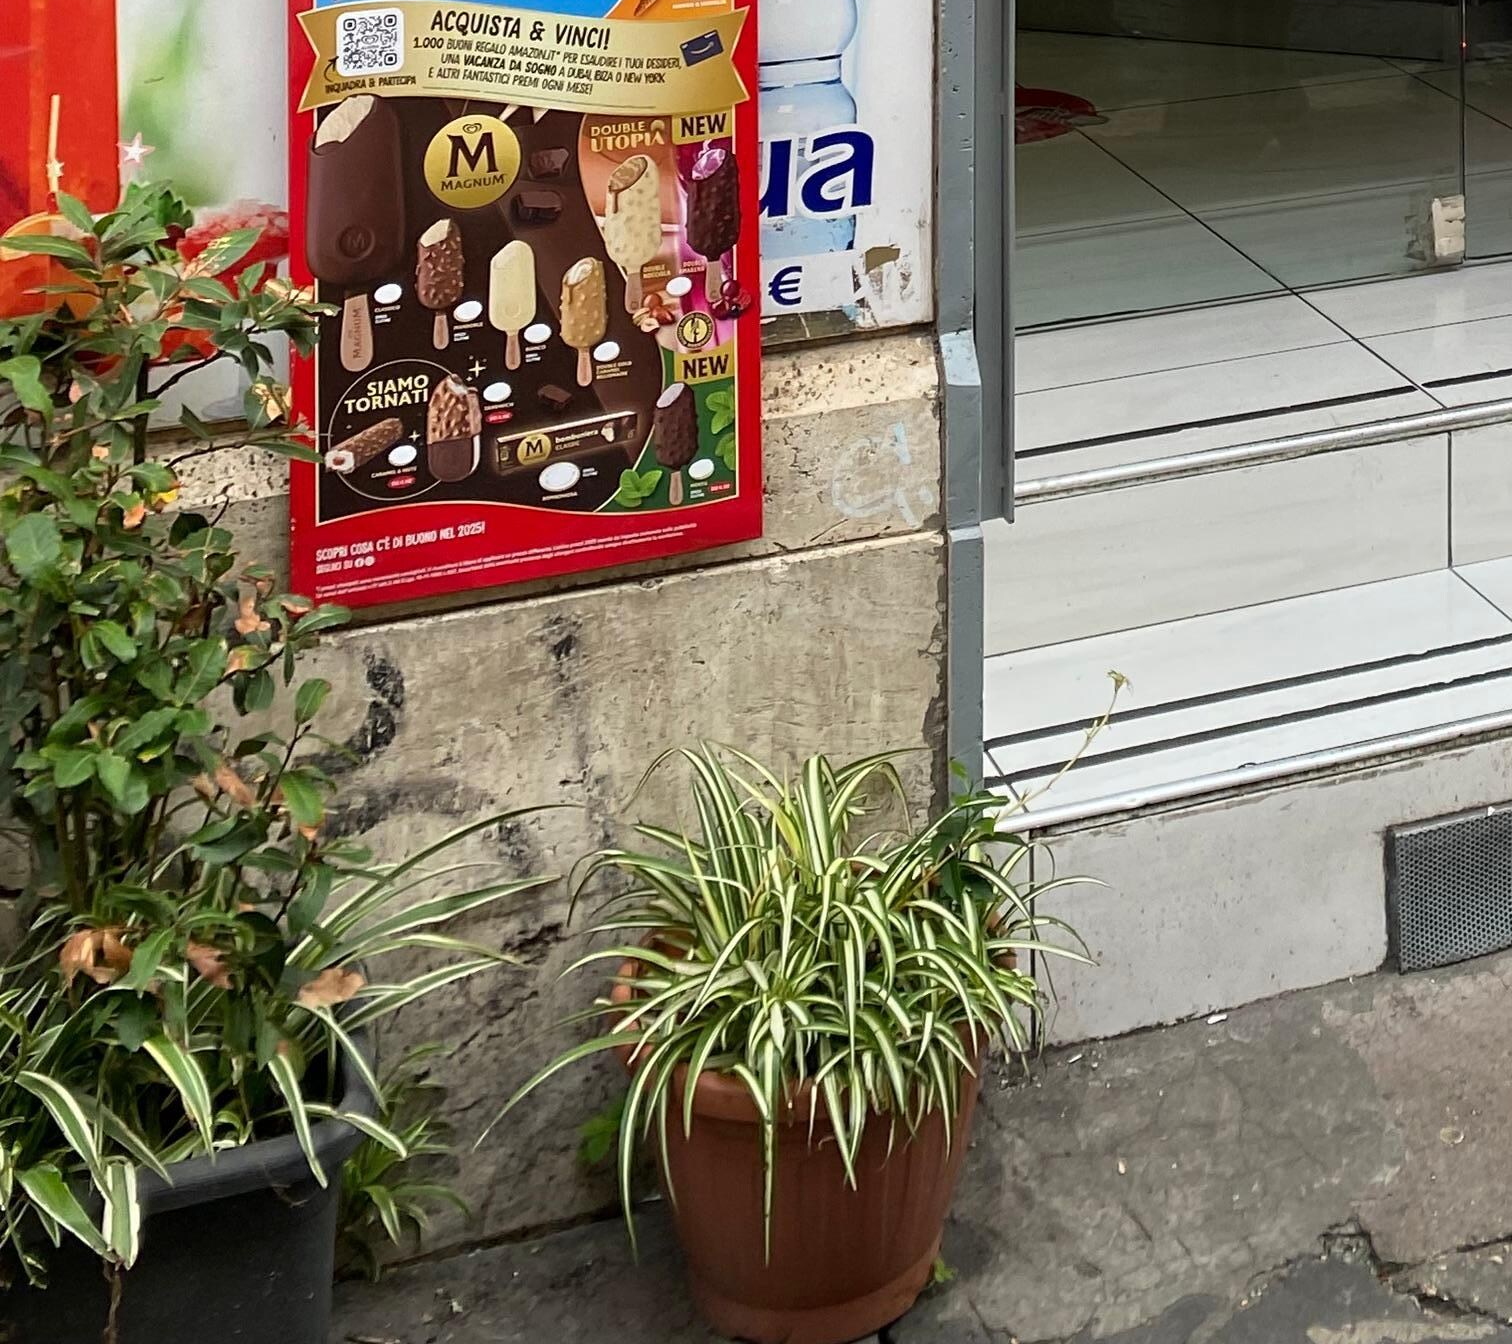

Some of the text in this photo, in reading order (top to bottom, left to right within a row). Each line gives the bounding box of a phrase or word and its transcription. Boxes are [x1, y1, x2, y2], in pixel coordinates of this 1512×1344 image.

[431, 10, 610, 50] ACQUISTA & VINCI!
[591, 120, 646, 137] DOUBLE
[681, 113, 728, 138] NEW
[446, 131, 500, 178] M
[591, 131, 665, 153] UTOPIA
[441, 174, 507, 191] MAGNUM
[768, 264, 803, 307] €
[682, 354, 729, 380] NEW
[367, 374, 430, 397] SIAMO
[344, 389, 429, 414] TORNATI
